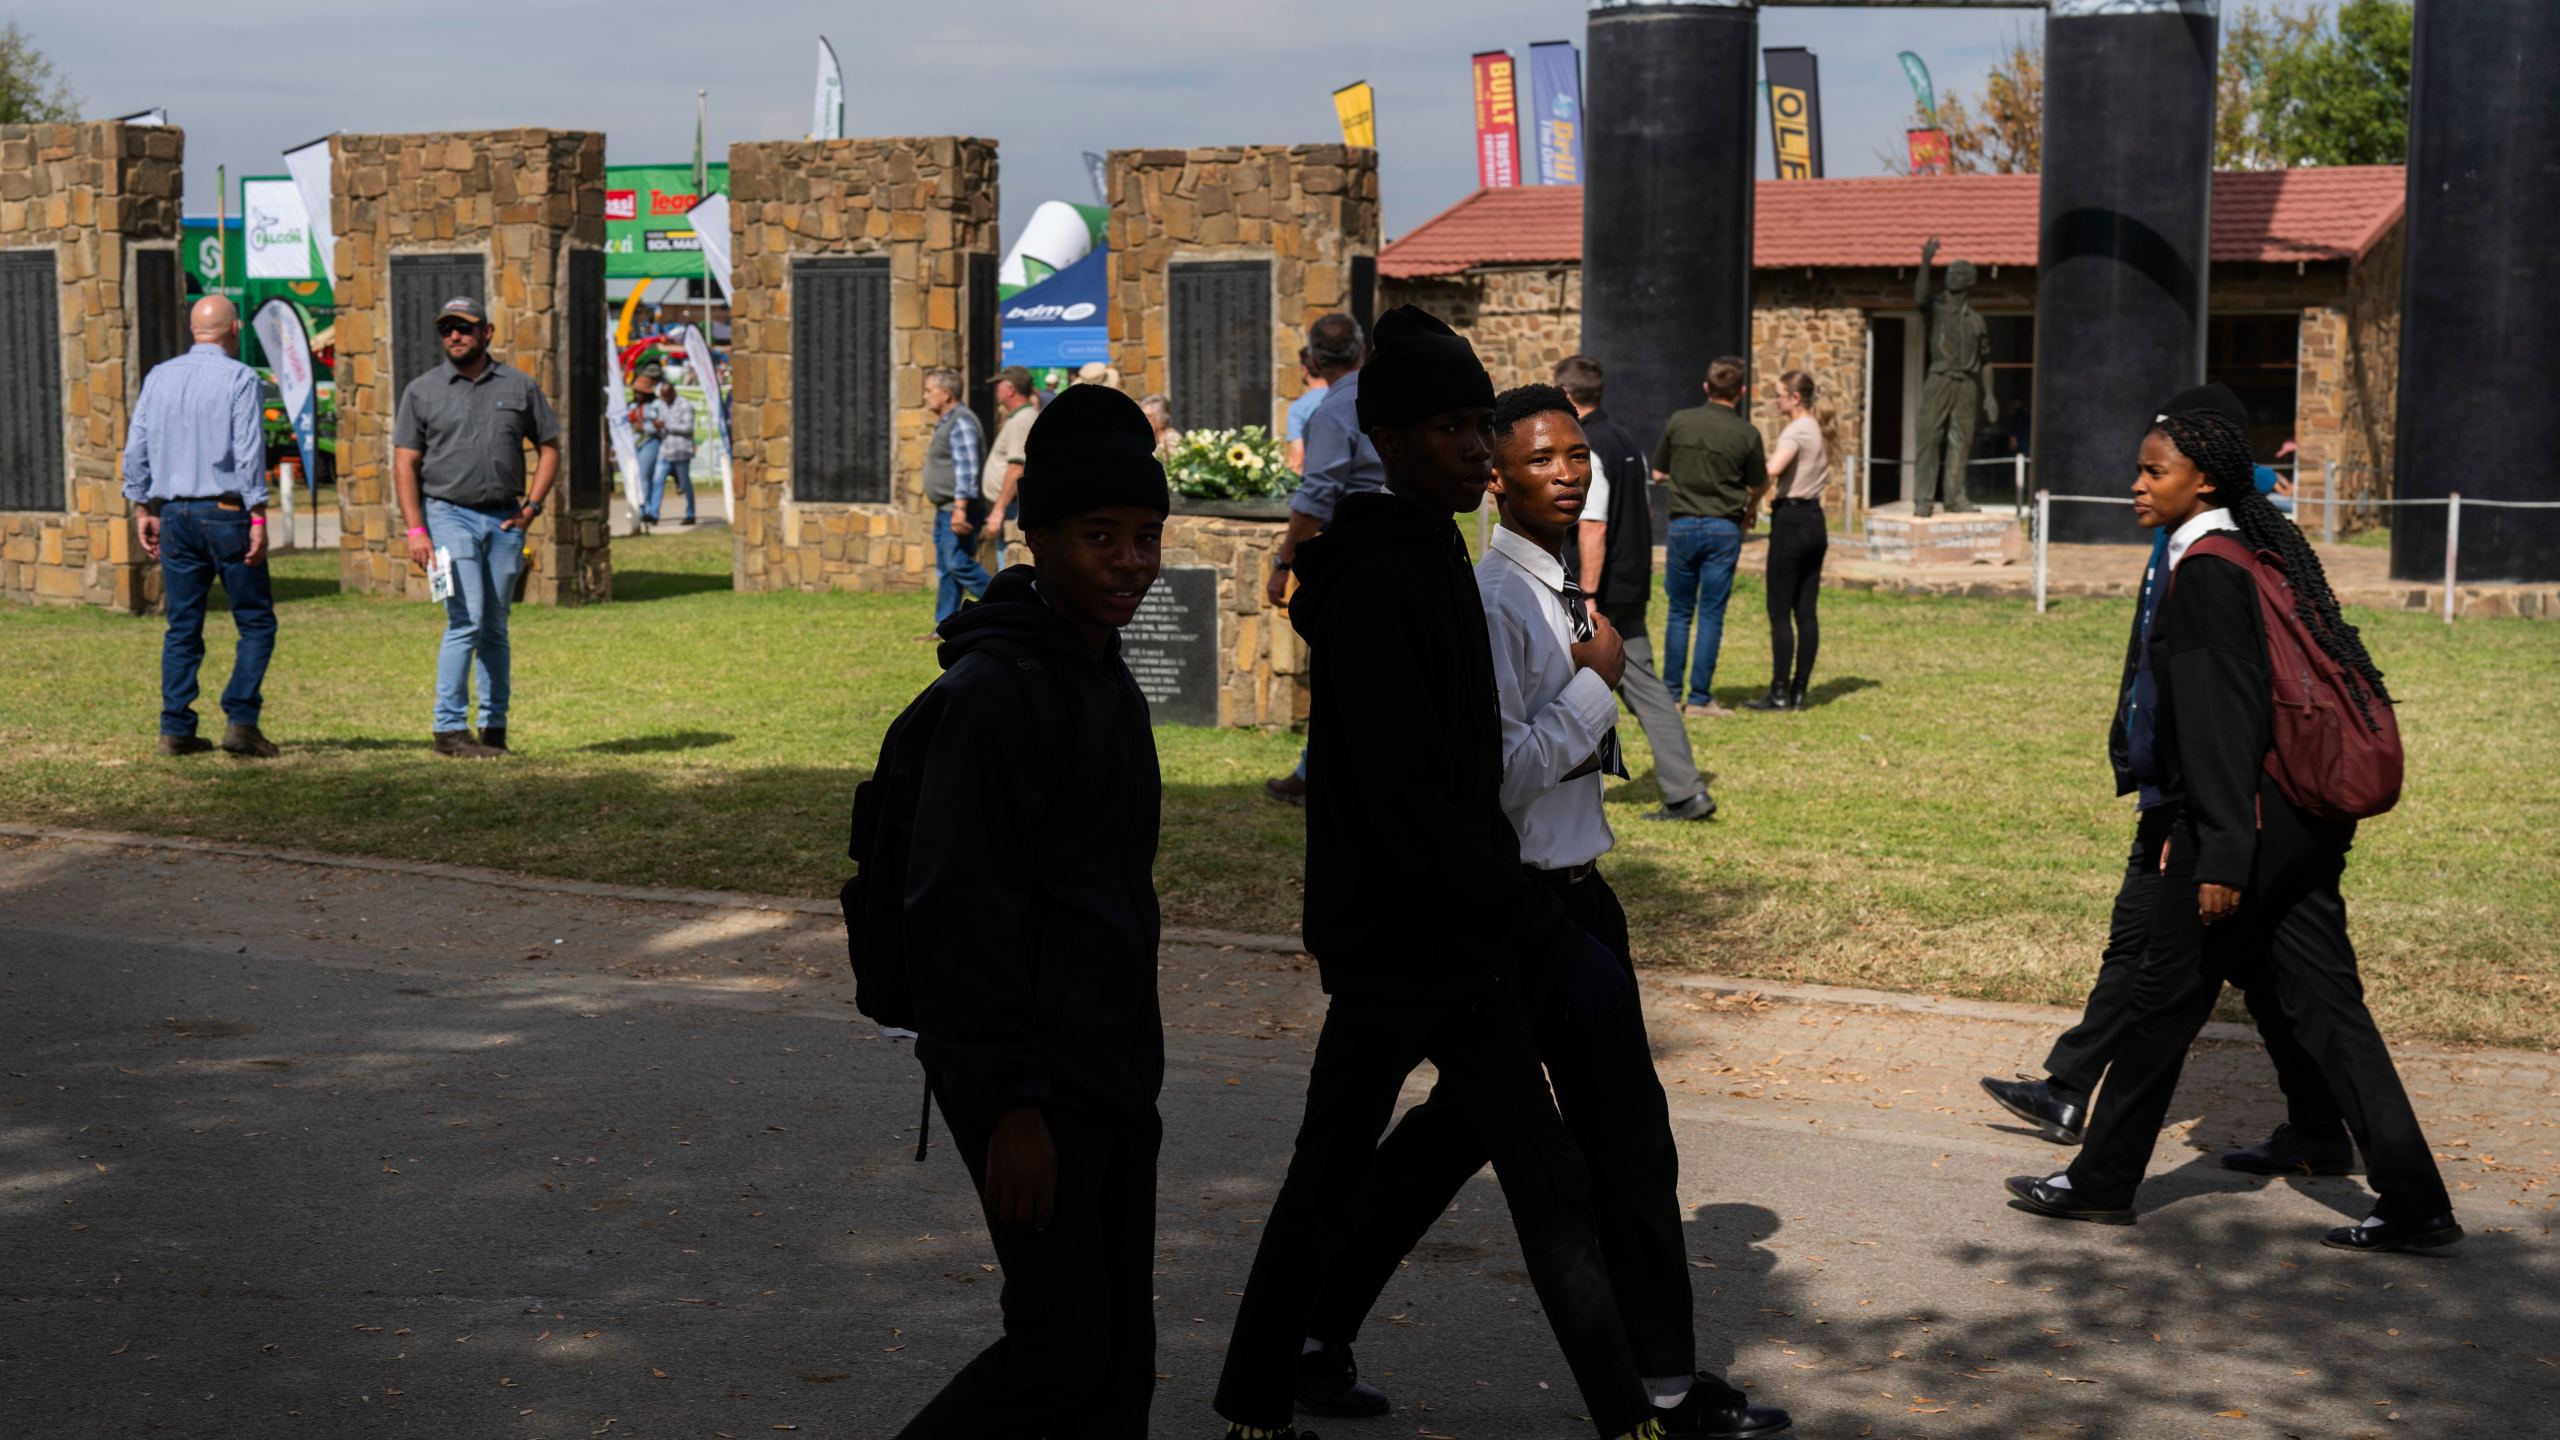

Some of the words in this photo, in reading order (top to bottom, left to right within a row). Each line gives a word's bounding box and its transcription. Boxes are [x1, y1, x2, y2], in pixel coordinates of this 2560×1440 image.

[1489, 61, 1515, 125] BUILT
[1552, 120, 1577, 181] Drill
[672, 239, 702, 251] MAS
